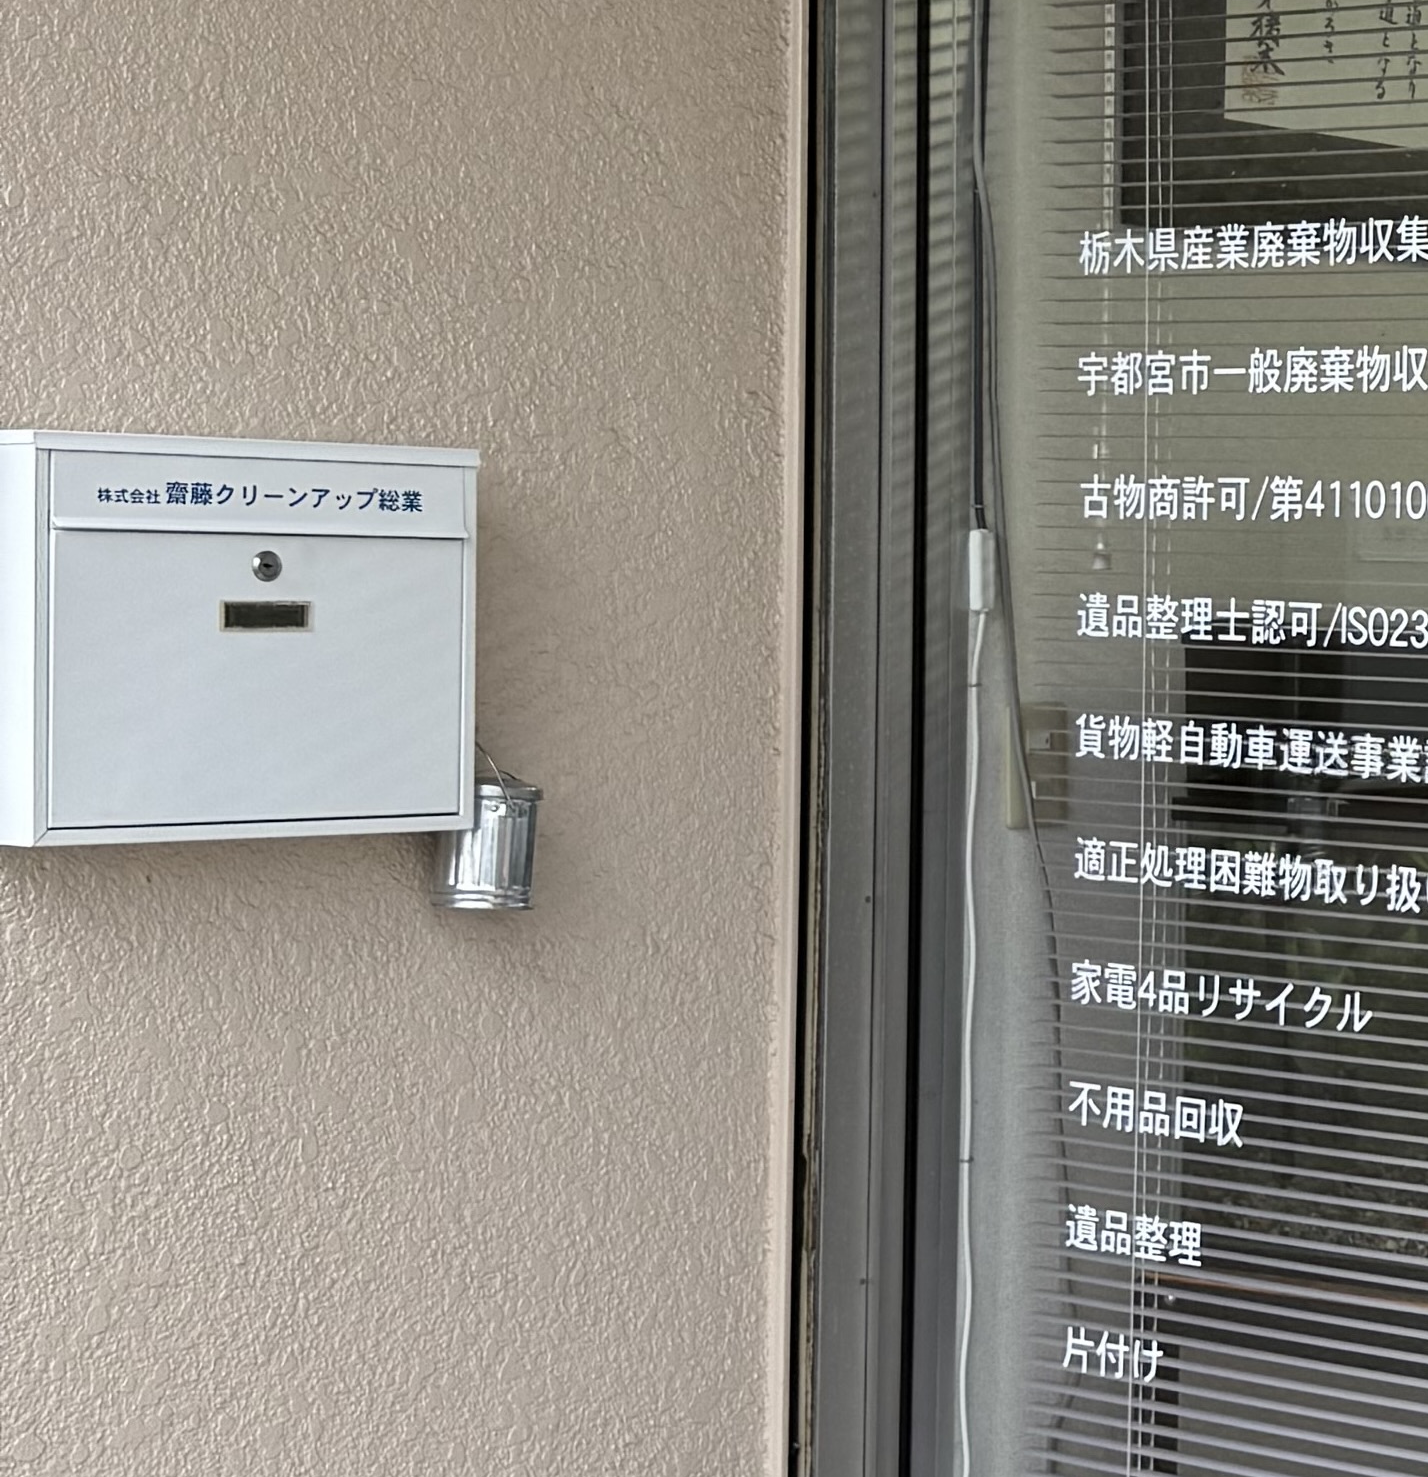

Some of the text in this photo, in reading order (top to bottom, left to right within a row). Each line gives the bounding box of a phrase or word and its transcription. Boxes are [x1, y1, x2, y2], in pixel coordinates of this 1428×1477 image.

[97, 486, 162, 506] 株式会社
[1071, 958, 1374, 1033] 家電4品リサイクル
[1069, 1080, 1244, 1148] 不用品回収
[1064, 1203, 1203, 1268] 遺品整理
[1062, 1325, 1164, 1383] 片付け
